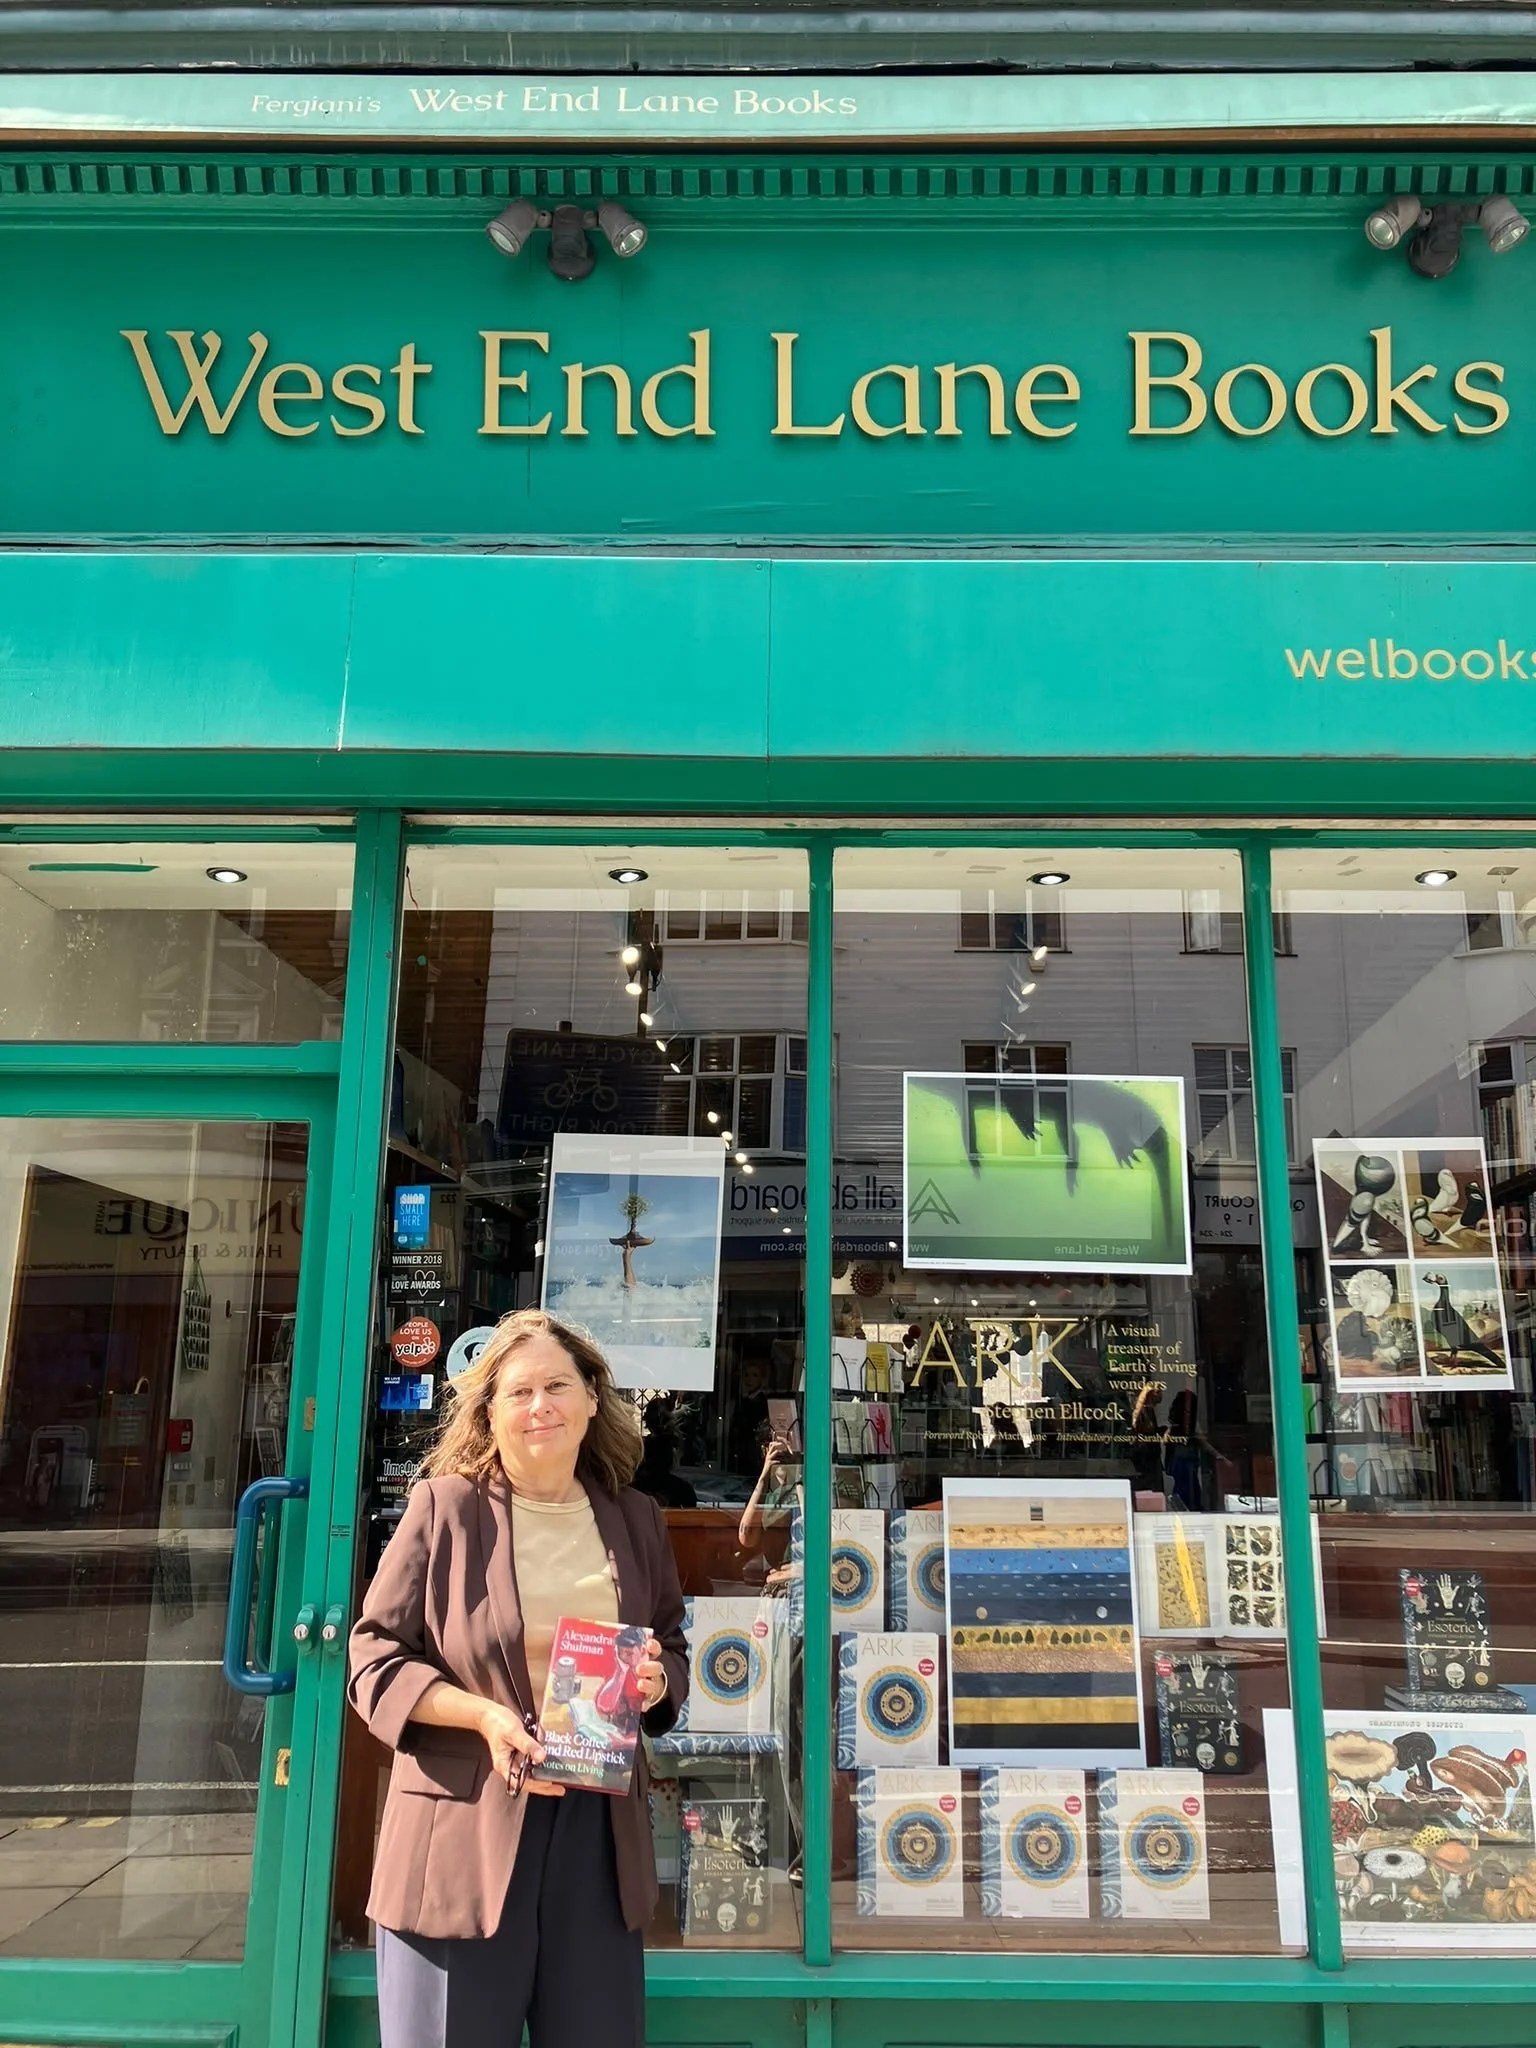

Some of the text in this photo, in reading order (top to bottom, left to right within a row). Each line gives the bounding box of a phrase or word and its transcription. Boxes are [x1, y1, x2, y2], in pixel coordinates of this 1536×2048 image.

[251, 95, 382, 117] Fergiani's
[409, 86, 857, 115] West End Lane Books
[119, 326, 1510, 437] West End Lane Books
[1284, 638, 1536, 680] welbook
[400, 1205, 424, 1215] SMALL
[402, 1215, 421, 1226] HERE
[392, 1255, 442, 1265] WINNER 2018
[391, 1280, 441, 1289] LOVE AWARDS
[422, 1328, 433, 1336] US
[1107, 1324, 1160, 1338] A visual
[395, 1342, 422, 1358] yelp
[909, 1320, 1084, 1390] ARK
[1107, 1342, 1182, 1356] treasury of
[1108, 1359, 1198, 1376] Earth's living
[1108, 1379, 1168, 1391] wonders
[1059, 1404, 1126, 1421] Ellcock
[1427, 1620, 1476, 1633] Esoteric
[562, 1629, 615, 1646] Alexandra
[560, 1641, 604, 1656] Shulman
[862, 1637, 904, 1656] ARK
[1179, 1700, 1226, 1713] Esoteric
[544, 1730, 609, 1749] Black Coffee
[563, 1745, 584, 1760] Red
[585, 1748, 625, 1765] Lipstick
[565, 1763, 576, 1772] on
[577, 1763, 604, 1778] Living
[880, 1773, 928, 1793] ARK
[1004, 1773, 1049, 1794] ARK
